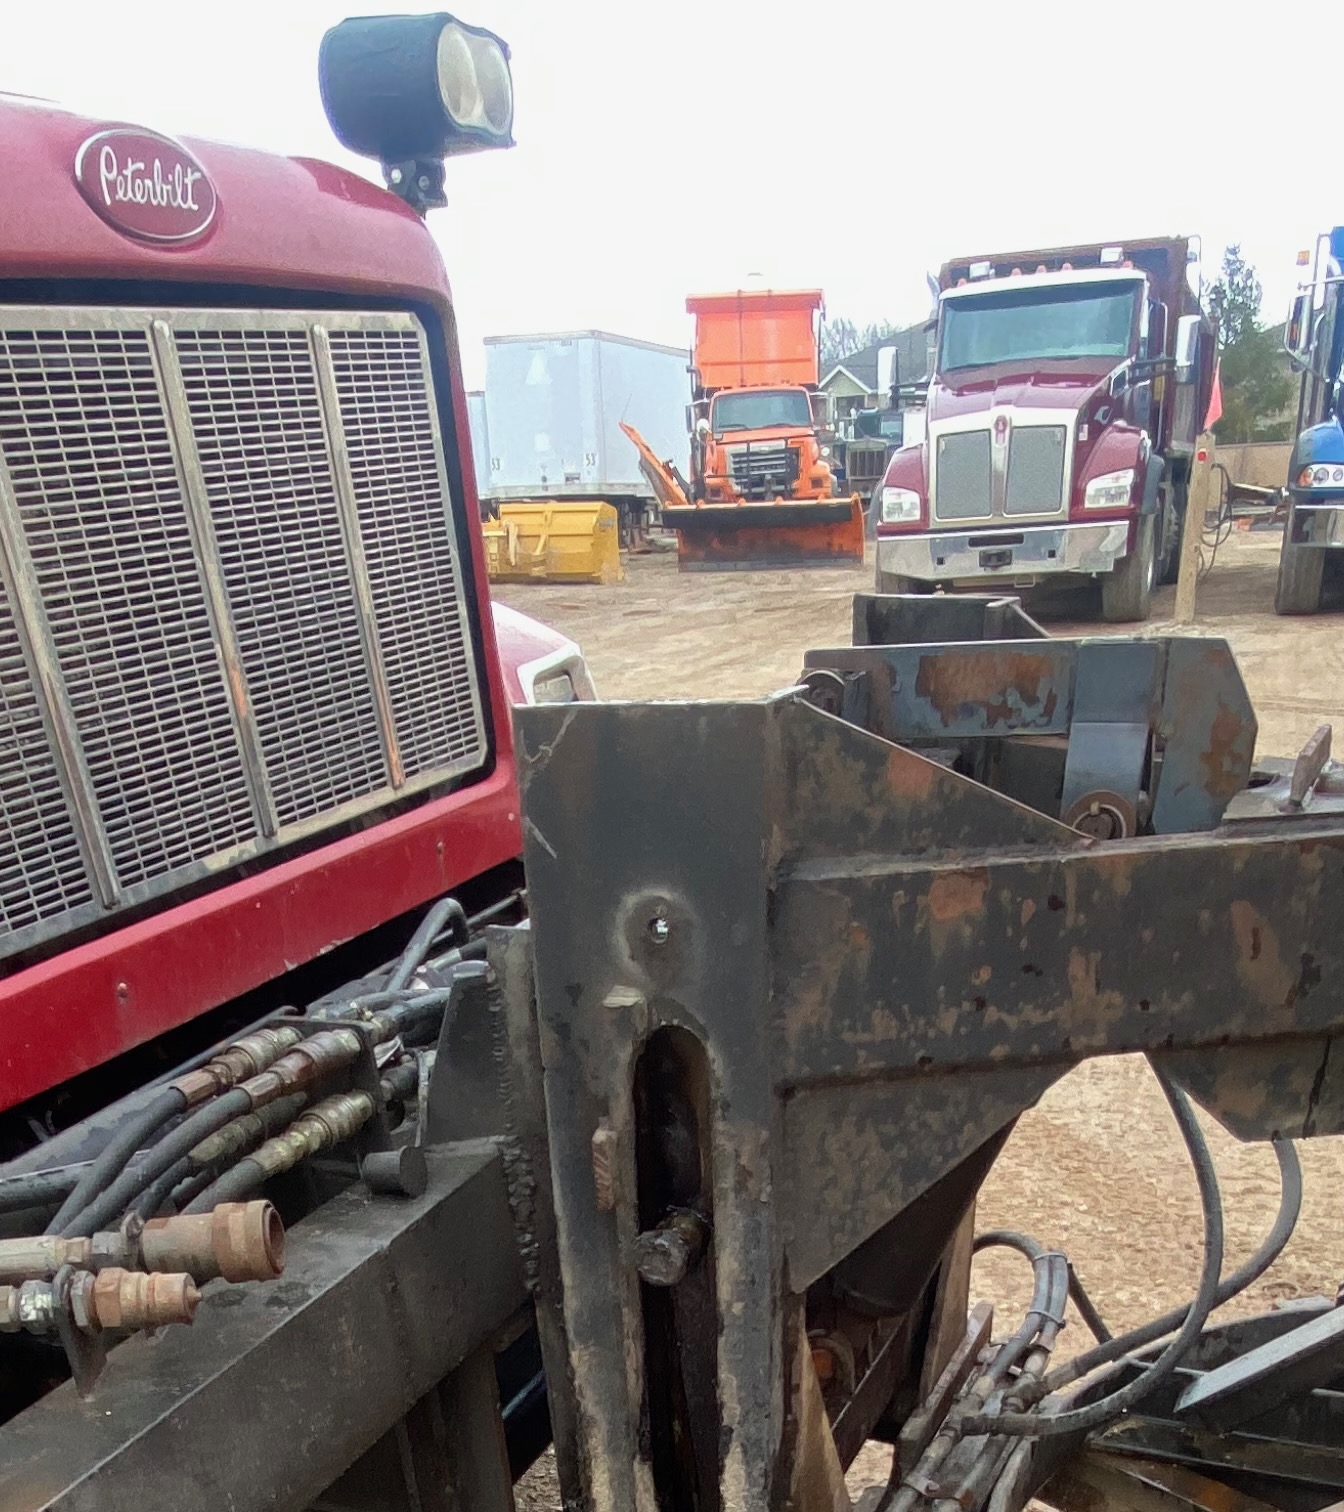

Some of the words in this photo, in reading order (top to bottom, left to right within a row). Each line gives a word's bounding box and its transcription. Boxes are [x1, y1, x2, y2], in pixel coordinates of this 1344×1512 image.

[99, 145, 202, 211] Peterbilt
[491, 457, 501, 472] 53
[585, 452, 596, 467] 53
